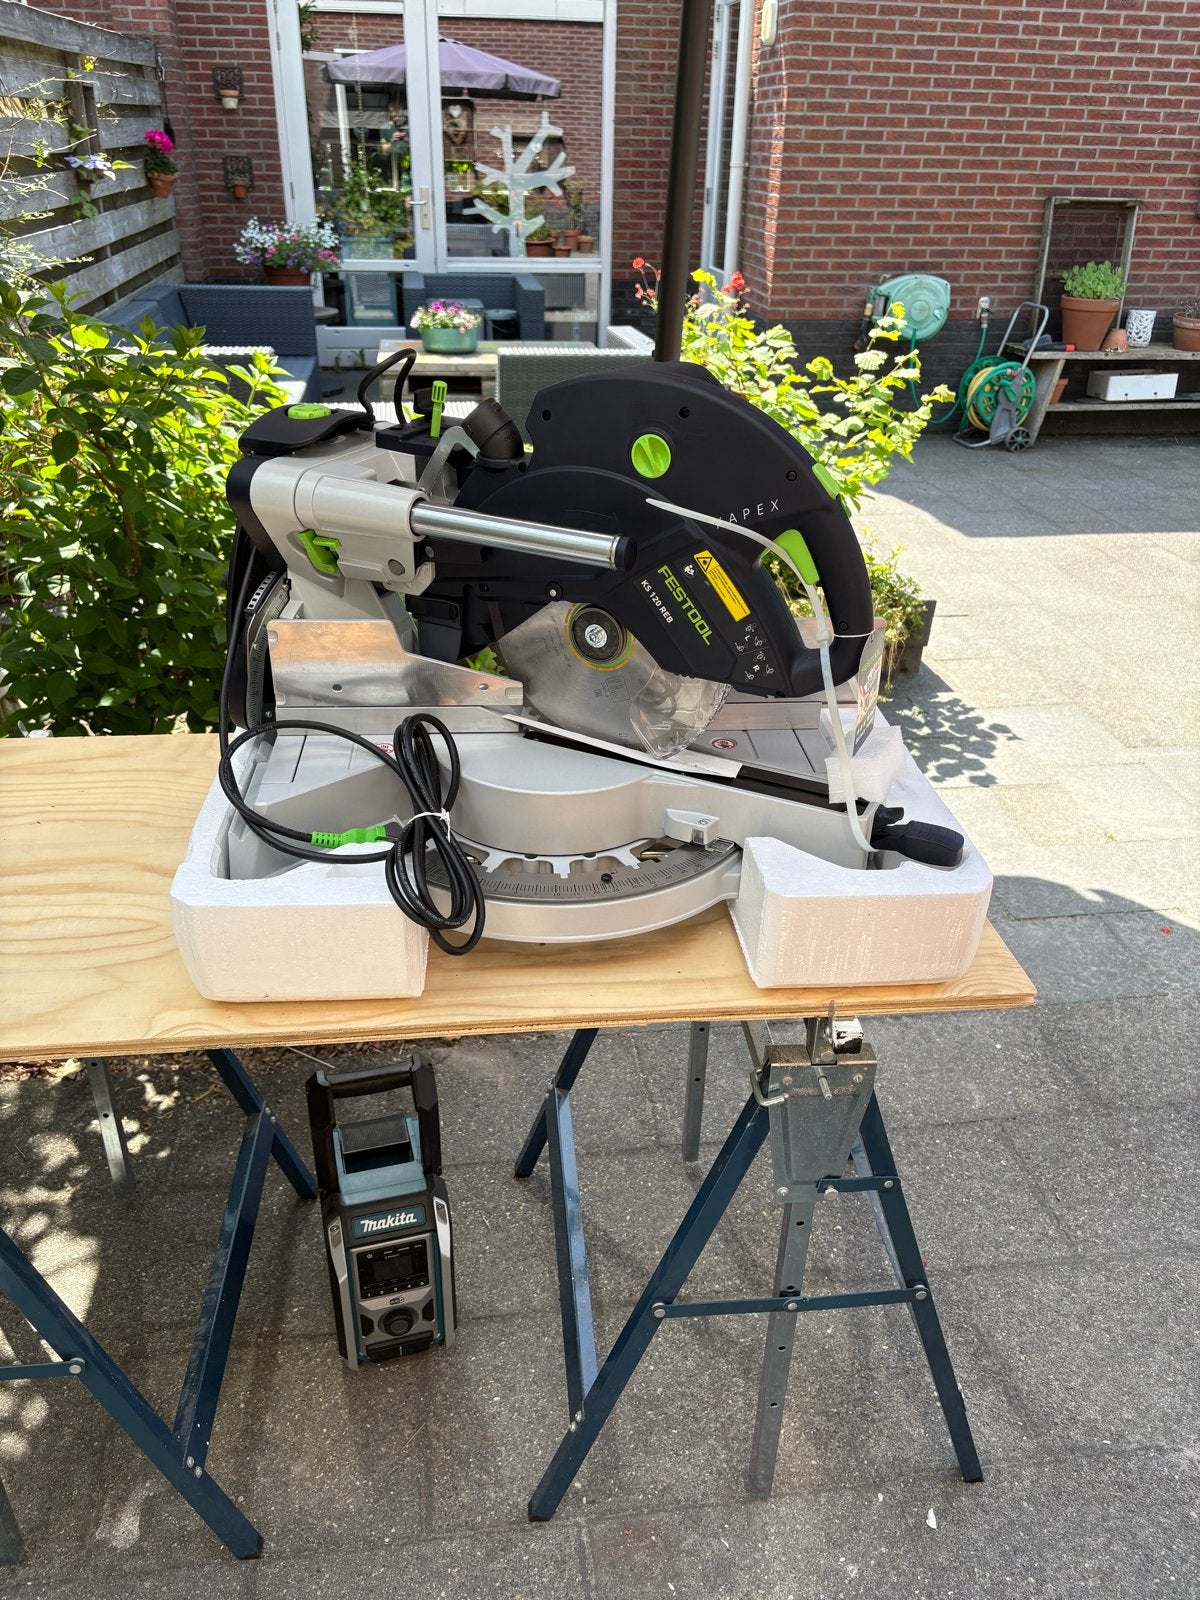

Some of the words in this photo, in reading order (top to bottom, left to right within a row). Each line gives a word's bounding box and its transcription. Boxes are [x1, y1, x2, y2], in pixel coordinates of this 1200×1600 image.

[717, 499, 779, 529] APEX
[641, 579, 653, 592] KS
[649, 591, 662, 607] 120
[659, 606, 674, 624] REB
[657, 565, 713, 646] FESTOOL
[752, 664, 760, 672] R
[360, 1212, 418, 1233] Makita
